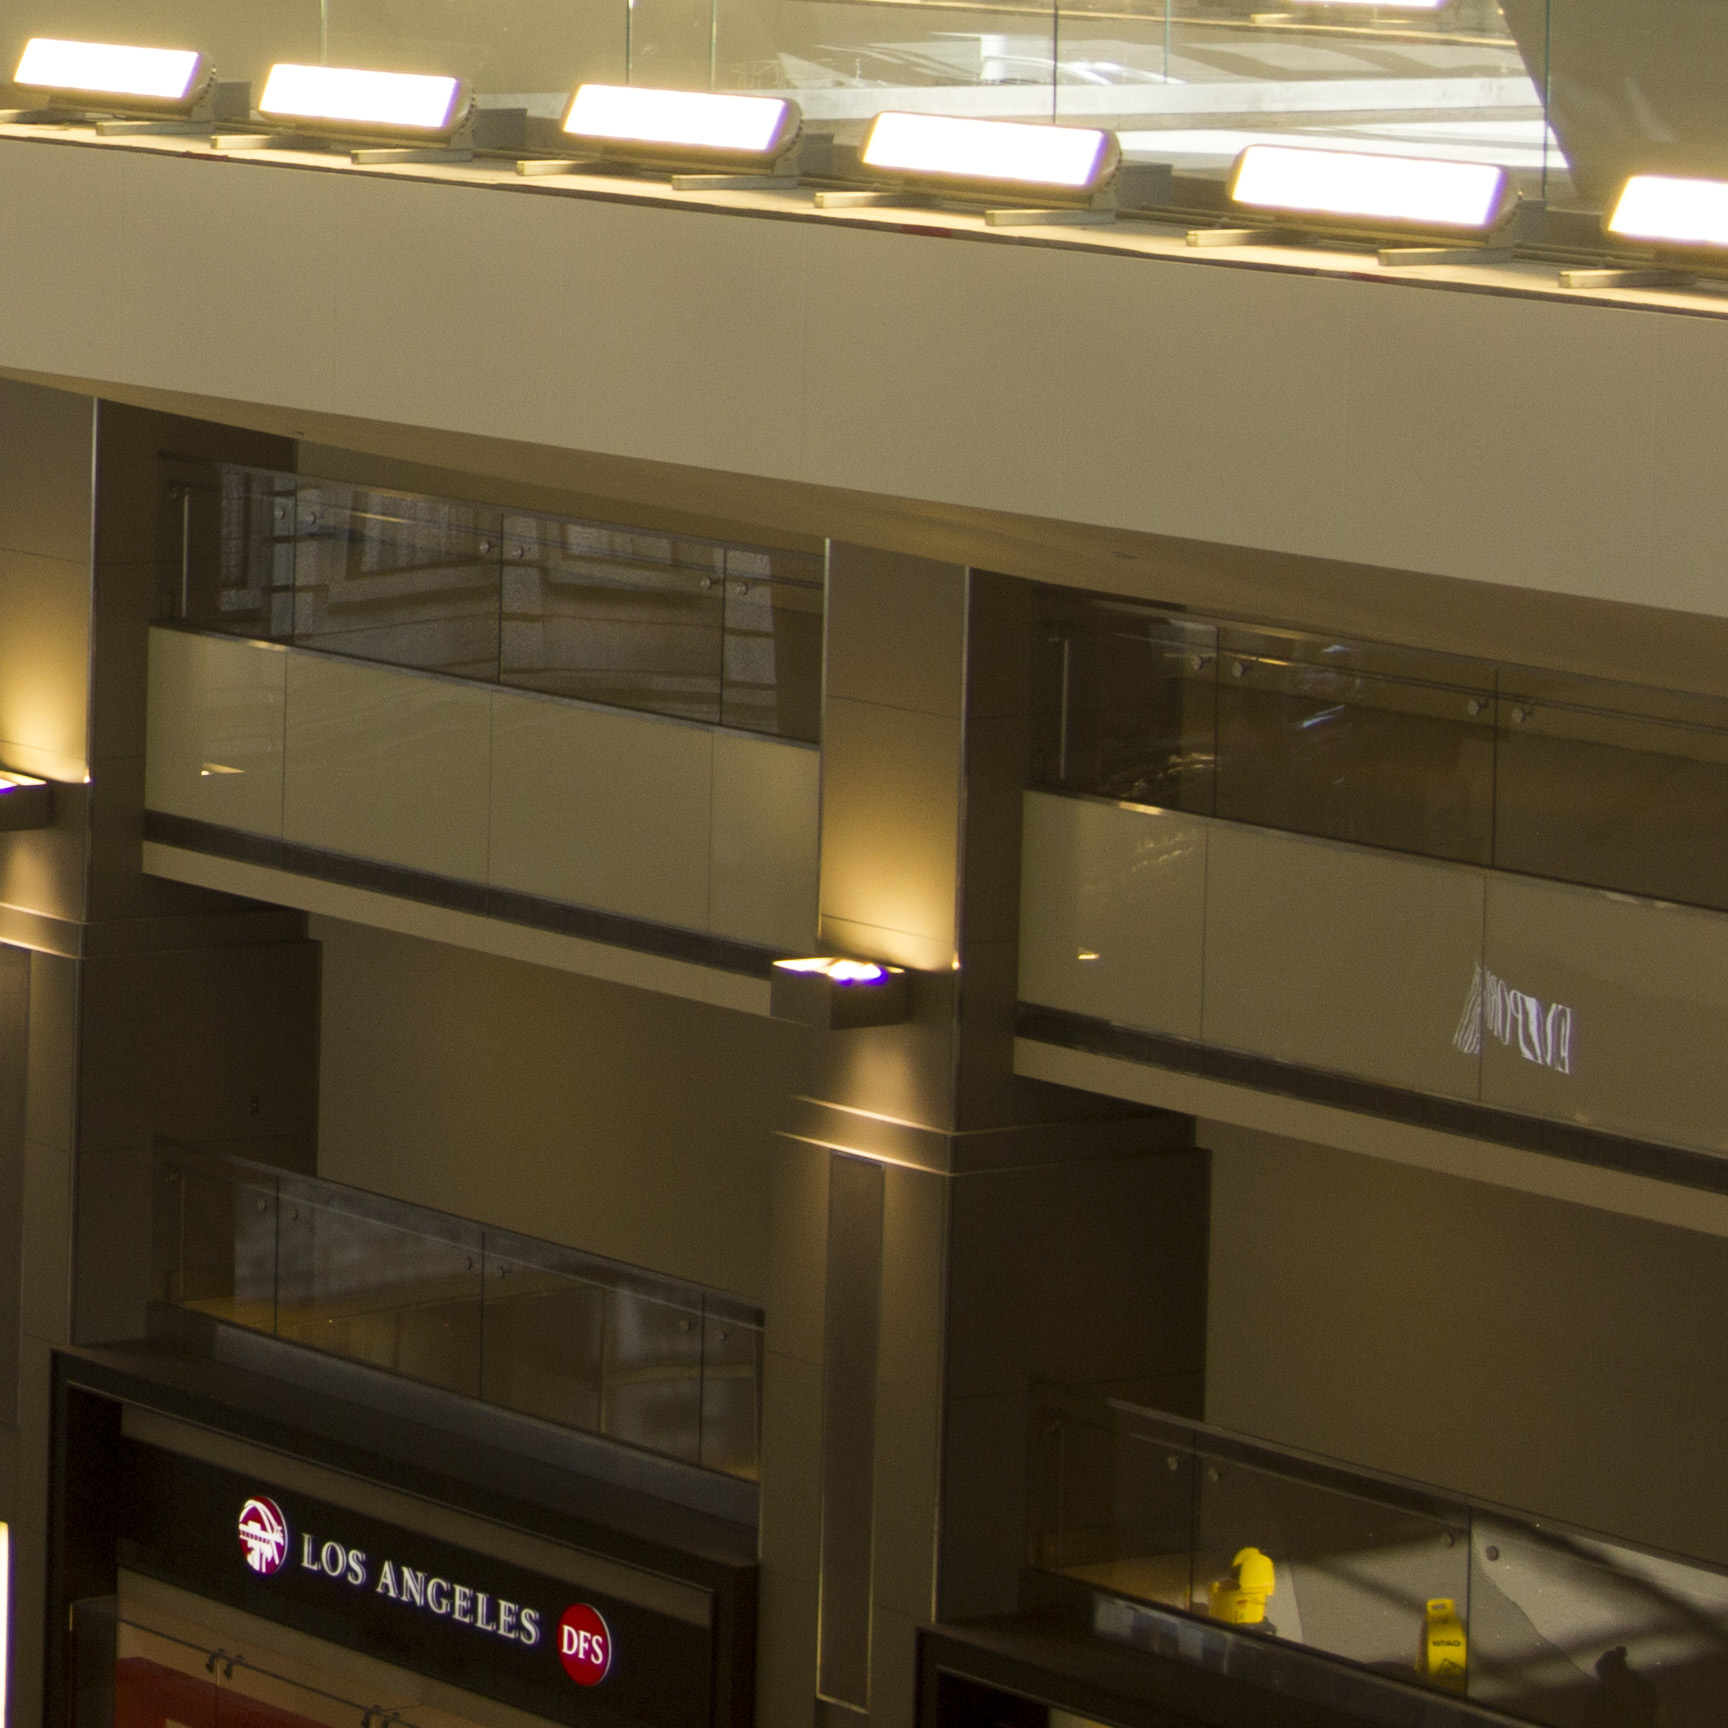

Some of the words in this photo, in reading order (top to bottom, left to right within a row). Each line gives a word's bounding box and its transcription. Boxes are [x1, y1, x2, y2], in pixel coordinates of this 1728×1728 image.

[301, 1532, 367, 1587] LOS
[376, 1559, 541, 1648] ANGELES
[561, 1625, 604, 1665] DFS
